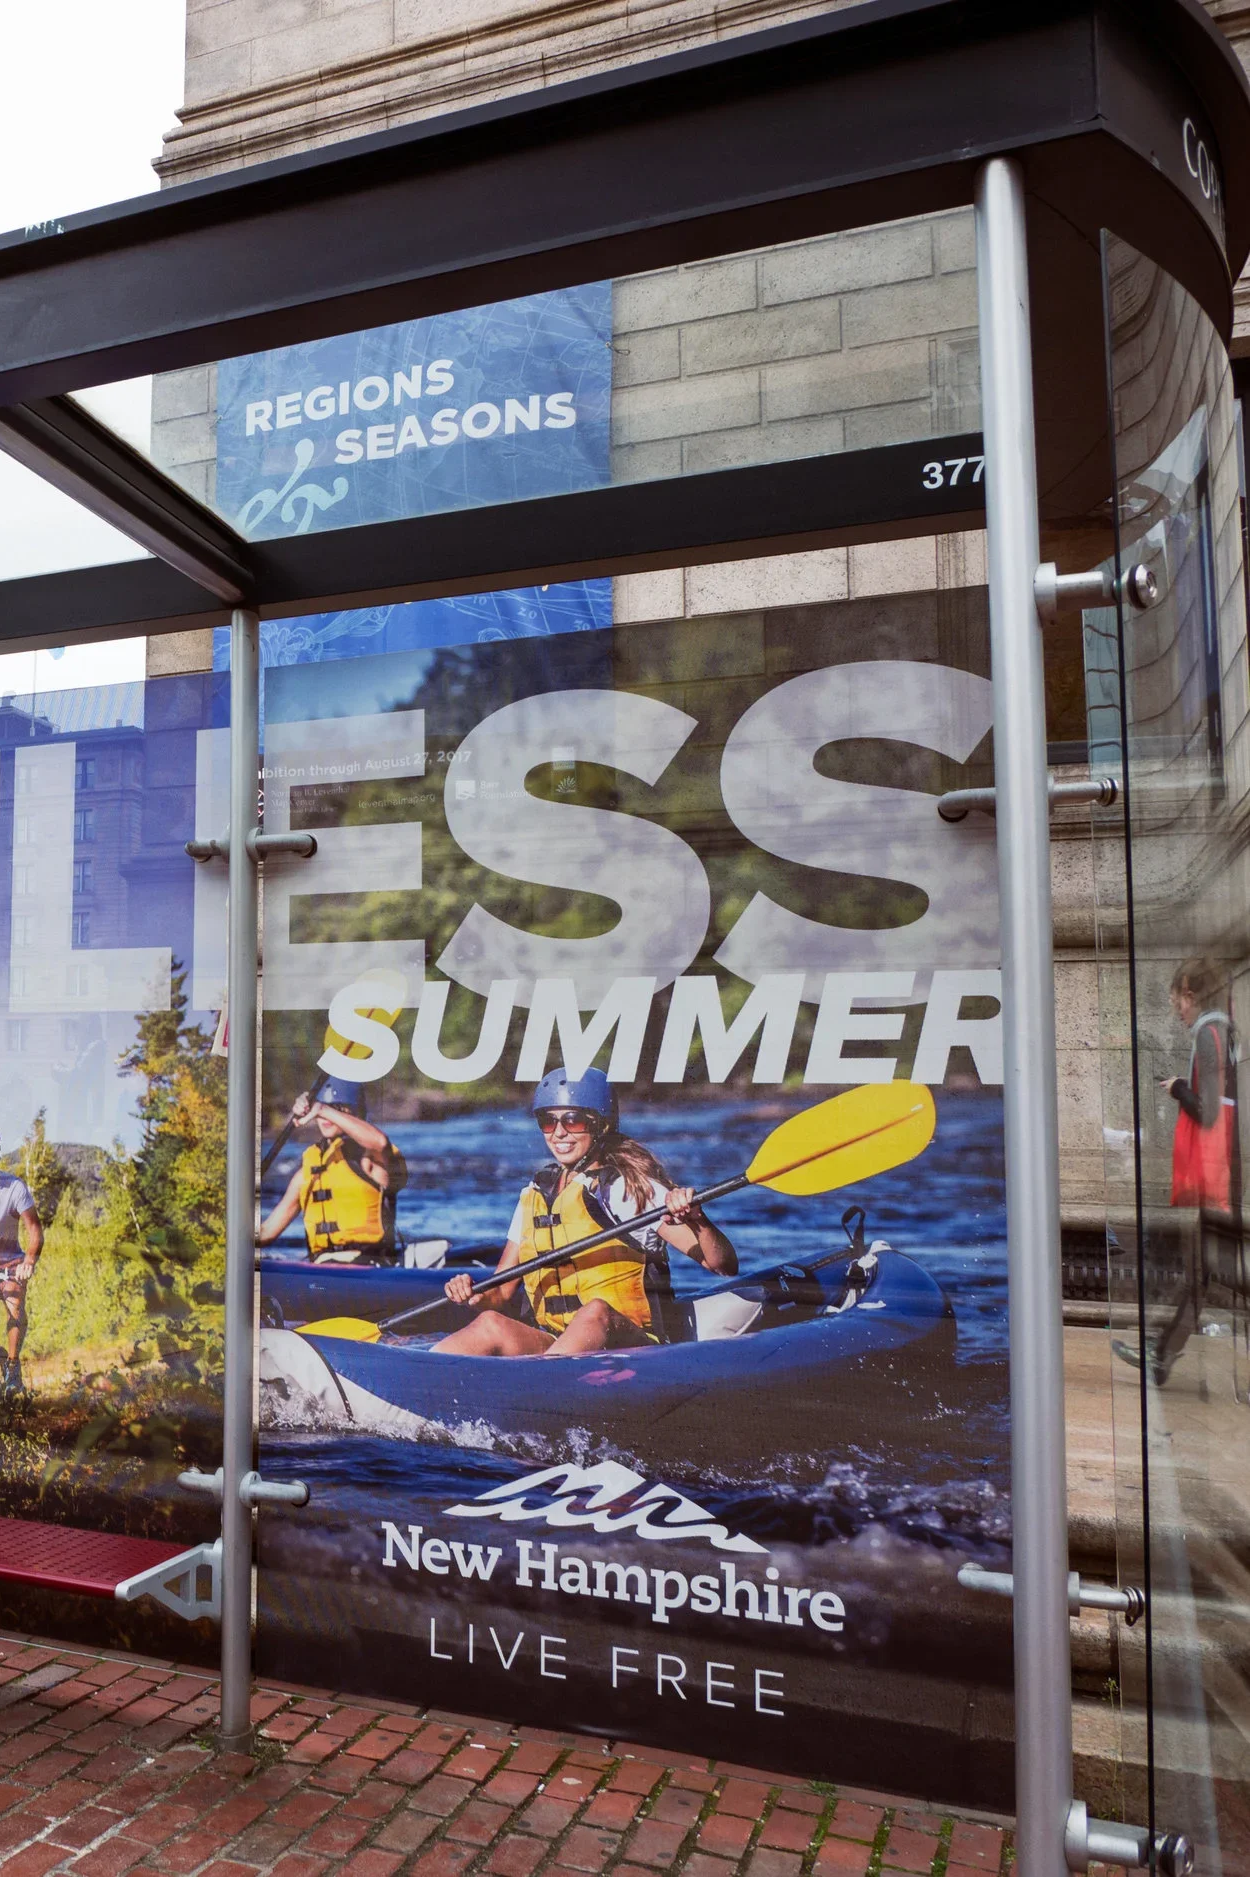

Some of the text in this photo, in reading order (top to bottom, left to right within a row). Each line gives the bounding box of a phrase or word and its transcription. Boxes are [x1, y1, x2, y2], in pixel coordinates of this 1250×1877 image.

[245, 359, 454, 437] REGIONS
[334, 392, 576, 465] SEASONS
[922, 455, 985, 490] 377
[258, 750, 472, 780] ibition through August 27, 2017
[316, 970, 1005, 1084] SUMMER
[381, 1520, 846, 1632] New Hampshire
[430, 1616, 785, 1717] LIVE FREE
